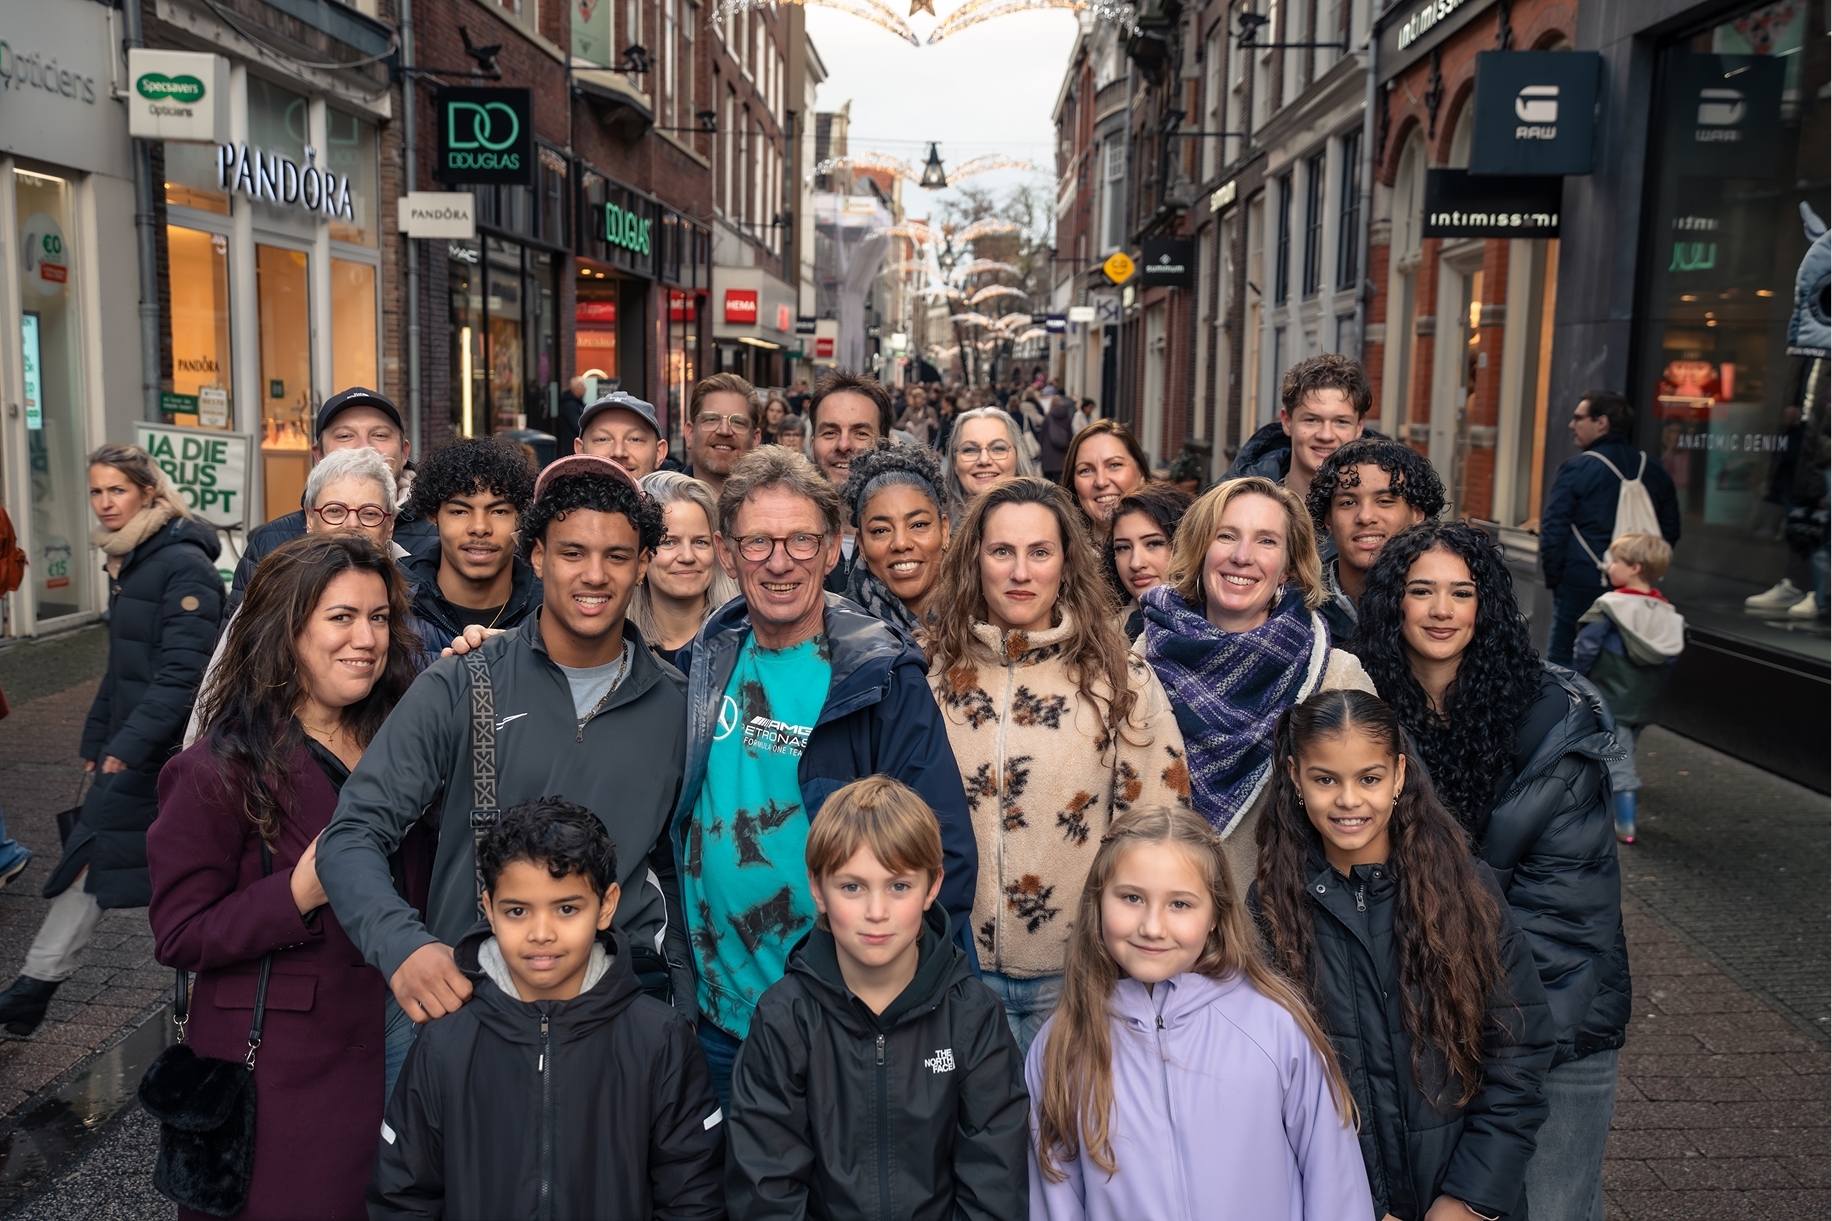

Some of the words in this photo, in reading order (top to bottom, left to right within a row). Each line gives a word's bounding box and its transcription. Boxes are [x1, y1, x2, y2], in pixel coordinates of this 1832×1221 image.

[1398, 0, 1464, 51] intimiss
[142, 79, 199, 95] Specsavers
[149, 104, 193, 117] Opticiens
[448, 101, 519, 151] DO
[1515, 126, 1557, 139] RAW
[448, 151, 520, 170] DOUGLAS
[606, 201, 650, 256] DOUGLAS
[448, 244, 479, 263] MAC
[1145, 264, 1185, 274] summum
[725, 299, 757, 312] HEMA
[182, 437, 228, 464] DIE
[1676, 432, 1740, 452] ANATOMIC
[1743, 433, 1789, 453] DENIM
[156, 459, 217, 487] RIJS
[177, 486, 237, 513] OPT
[767, 719, 814, 736] AMG
[743, 736, 772, 752] FORMULA
[772, 744, 787, 754] ONE
[789, 747, 803, 757] TEA
[924, 1055, 954, 1068] NORTH
[935, 1048, 953, 1058] THE
[932, 1063, 954, 1074] FACE
